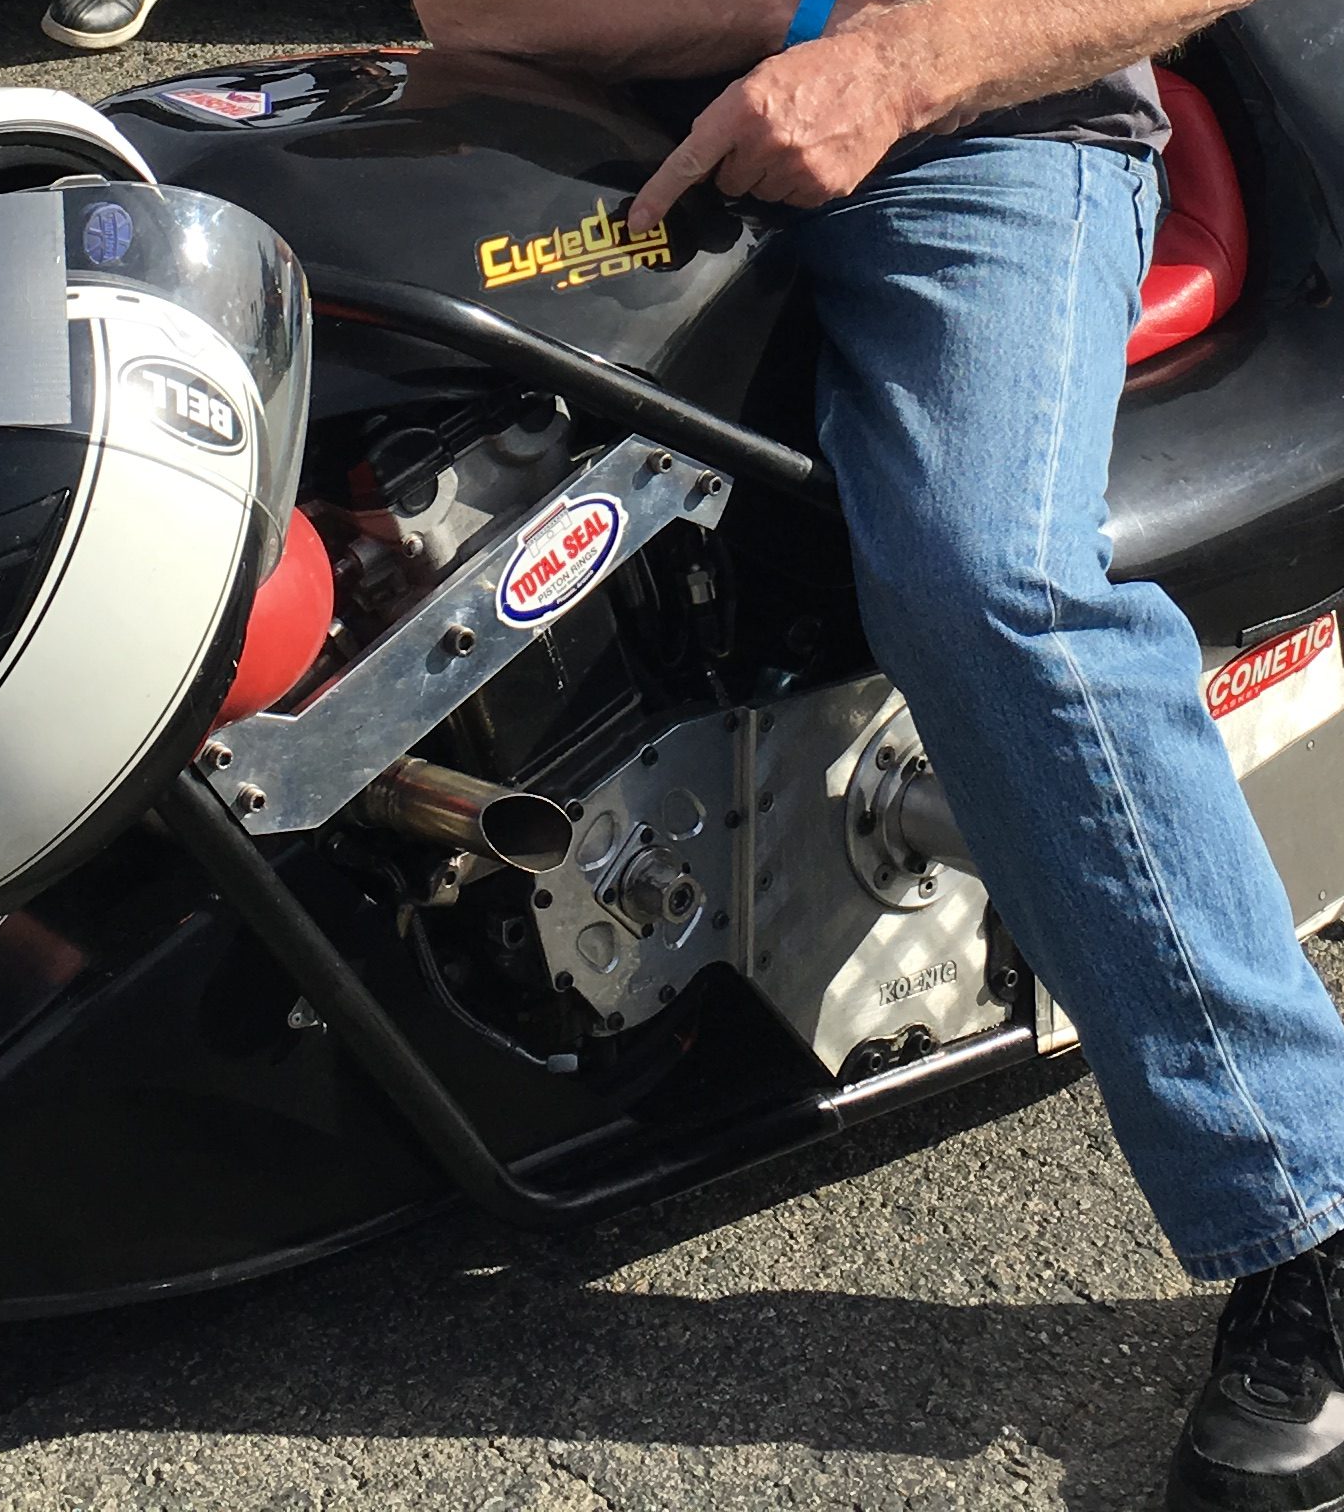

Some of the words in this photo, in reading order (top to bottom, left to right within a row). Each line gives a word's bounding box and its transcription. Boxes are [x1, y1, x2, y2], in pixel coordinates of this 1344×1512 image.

[556, 247, 671, 289] .com
[142, 371, 234, 442] BELL
[509, 550, 567, 605] TOTAL
[562, 511, 610, 561] SEAL
[537, 572, 571, 604] PISTON
[570, 548, 599, 575] RINGS
[1209, 614, 1334, 708] COMETIC
[878, 960, 958, 1006] KOENIG
